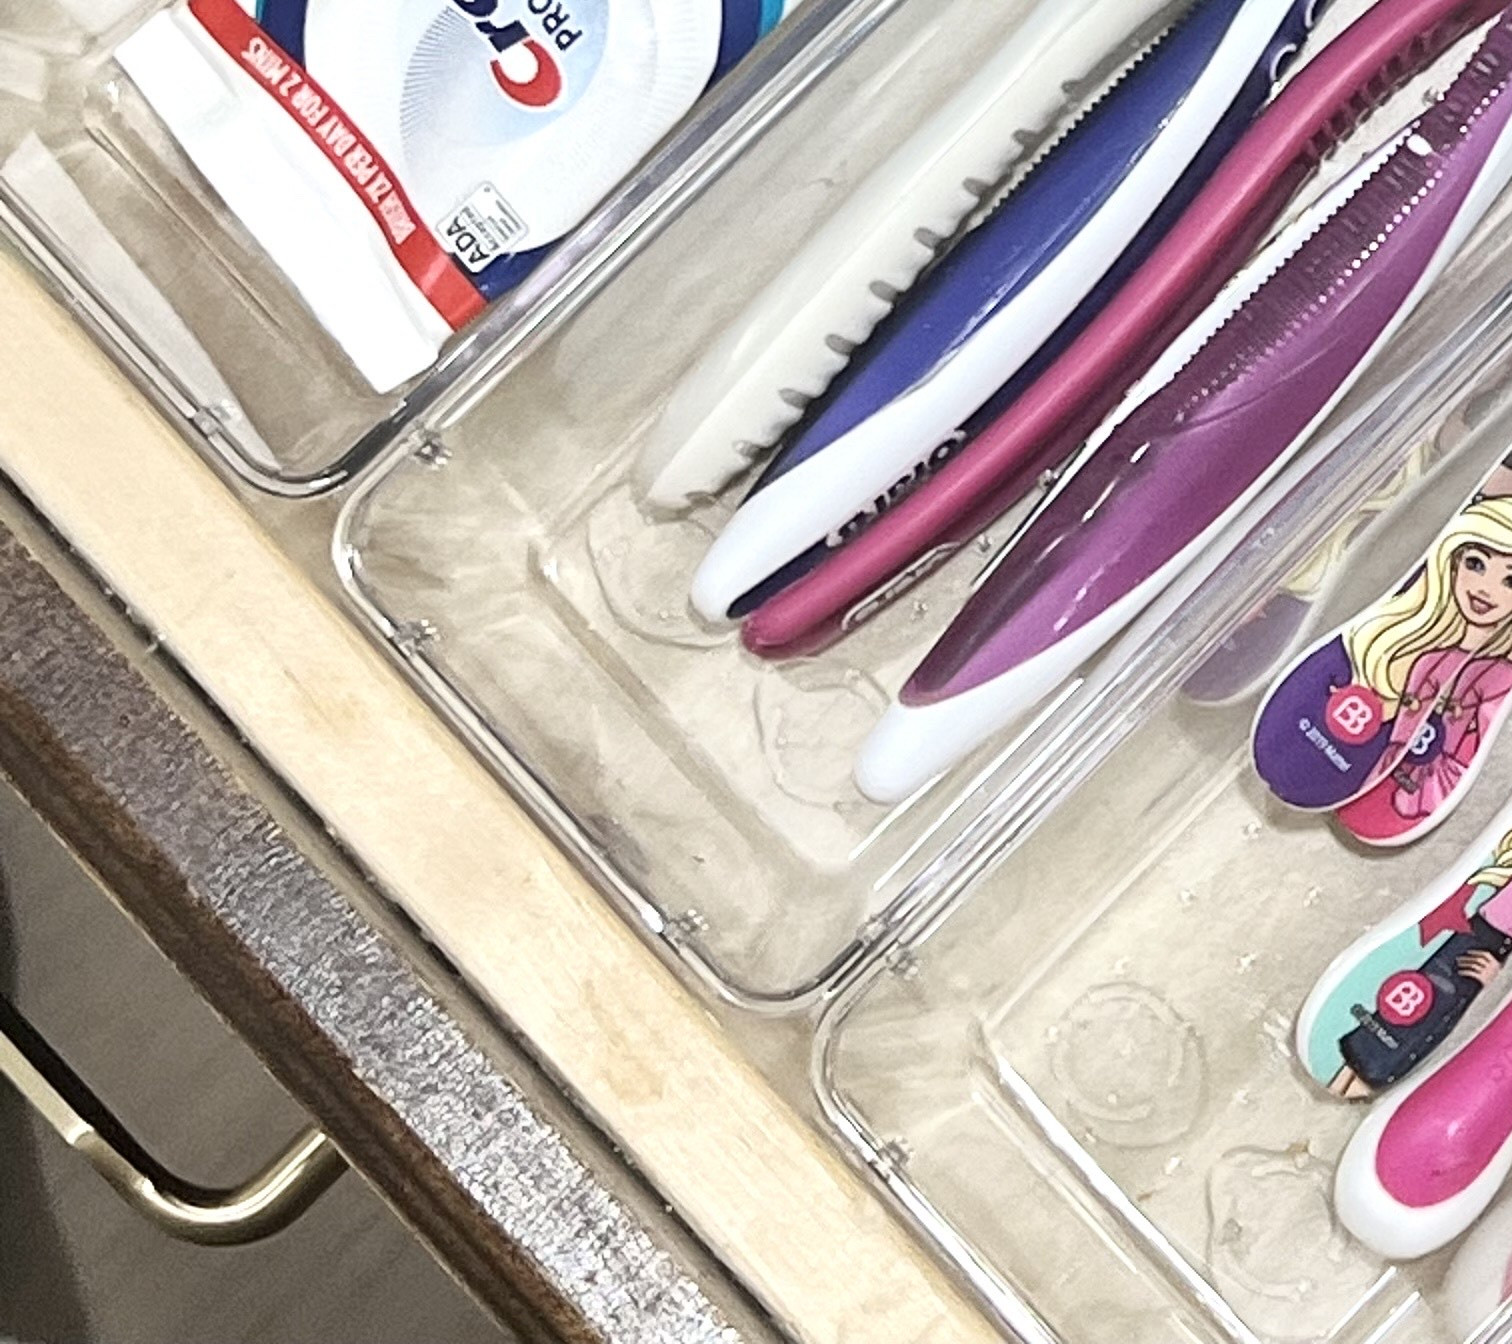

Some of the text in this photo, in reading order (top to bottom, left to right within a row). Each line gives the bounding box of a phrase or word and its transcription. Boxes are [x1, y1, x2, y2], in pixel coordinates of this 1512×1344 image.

[276, 71, 303, 97] 2
[287, 82, 331, 126] FOR
[315, 114, 359, 156] DAY
[340, 142, 380, 186] PER
[442, 215, 490, 268] ADA
